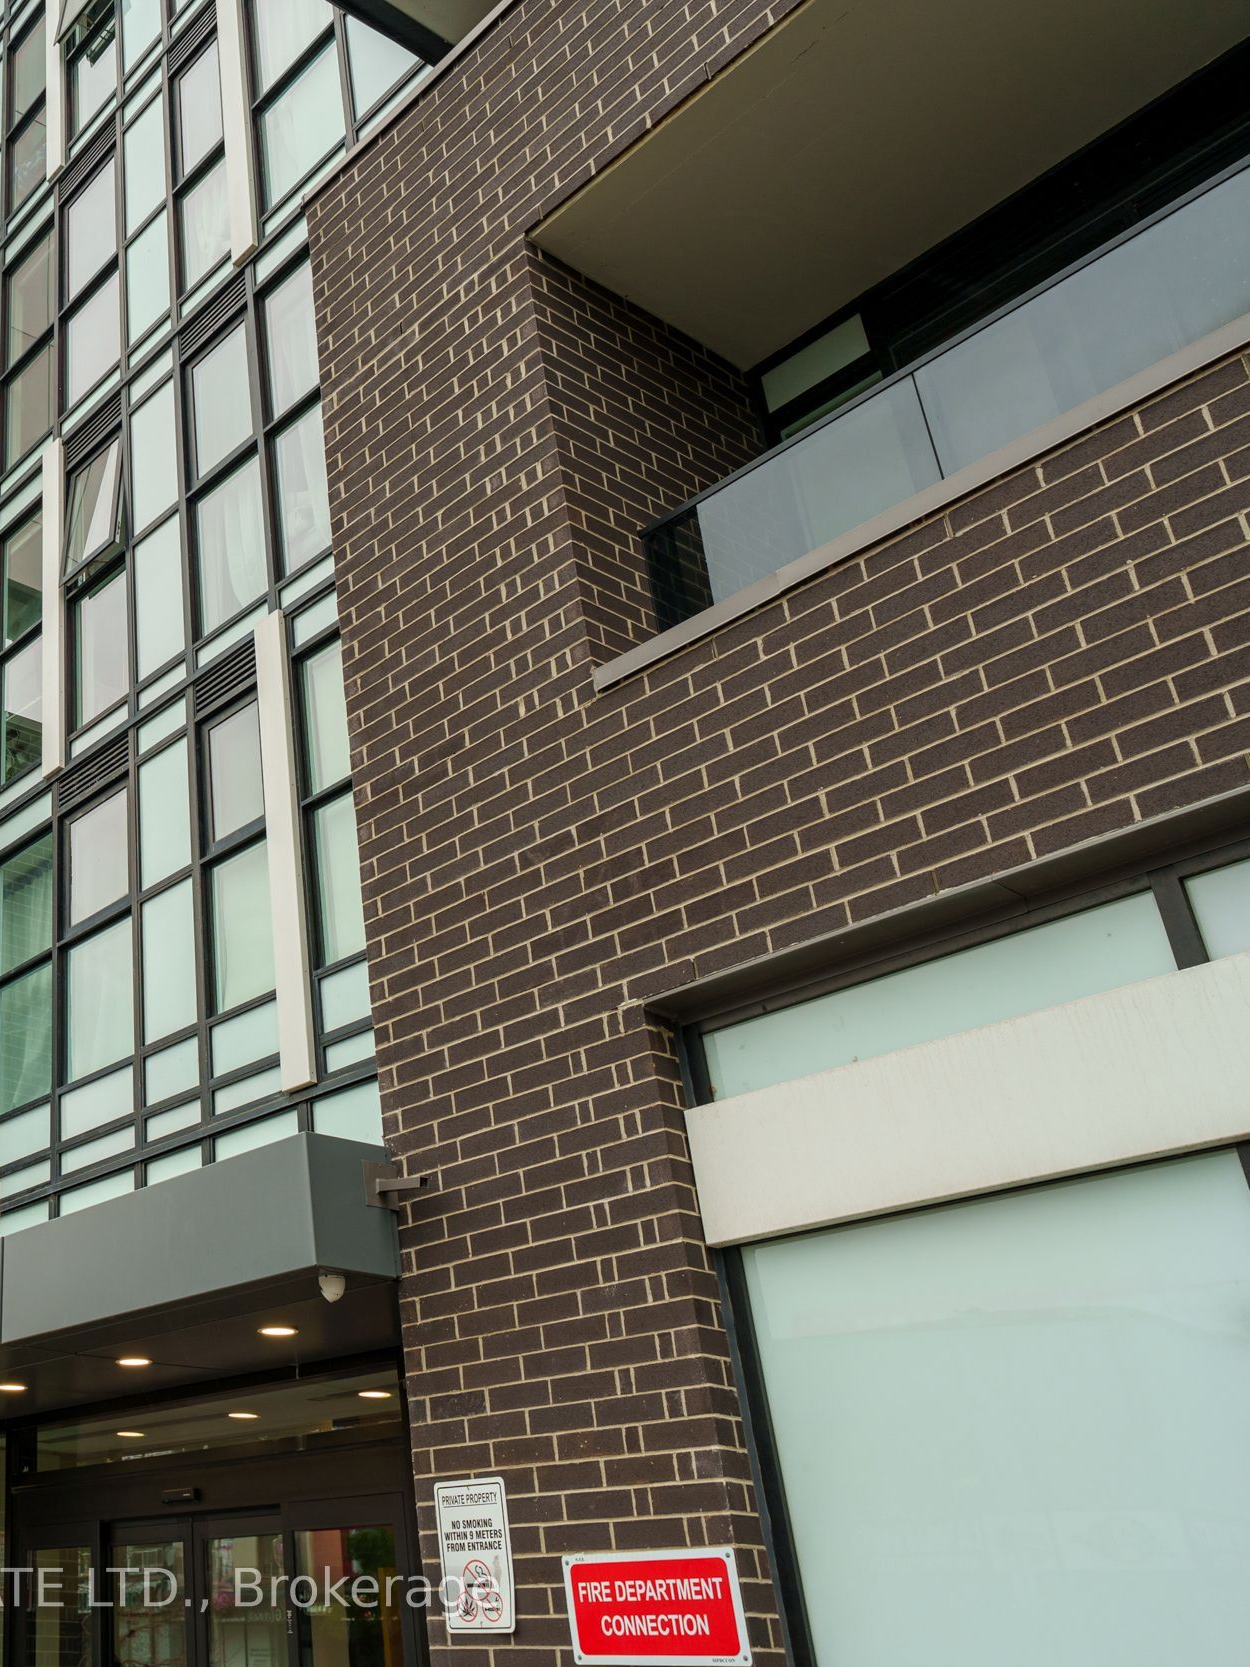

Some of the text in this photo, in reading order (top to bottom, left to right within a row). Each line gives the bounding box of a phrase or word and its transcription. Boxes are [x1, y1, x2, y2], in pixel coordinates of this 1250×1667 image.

[442, 1492, 497, 1506] PRIVATE PROPERTY
[451, 1518, 493, 1530] NO SMOKING
[444, 1528, 503, 1541] WITHIN 9 METERS
[446, 1540, 502, 1552] FROM ENTRANCE
[577, 1577, 723, 1603] FIRE DEPARTMENT
[601, 1613, 710, 1636] CONNECTION
